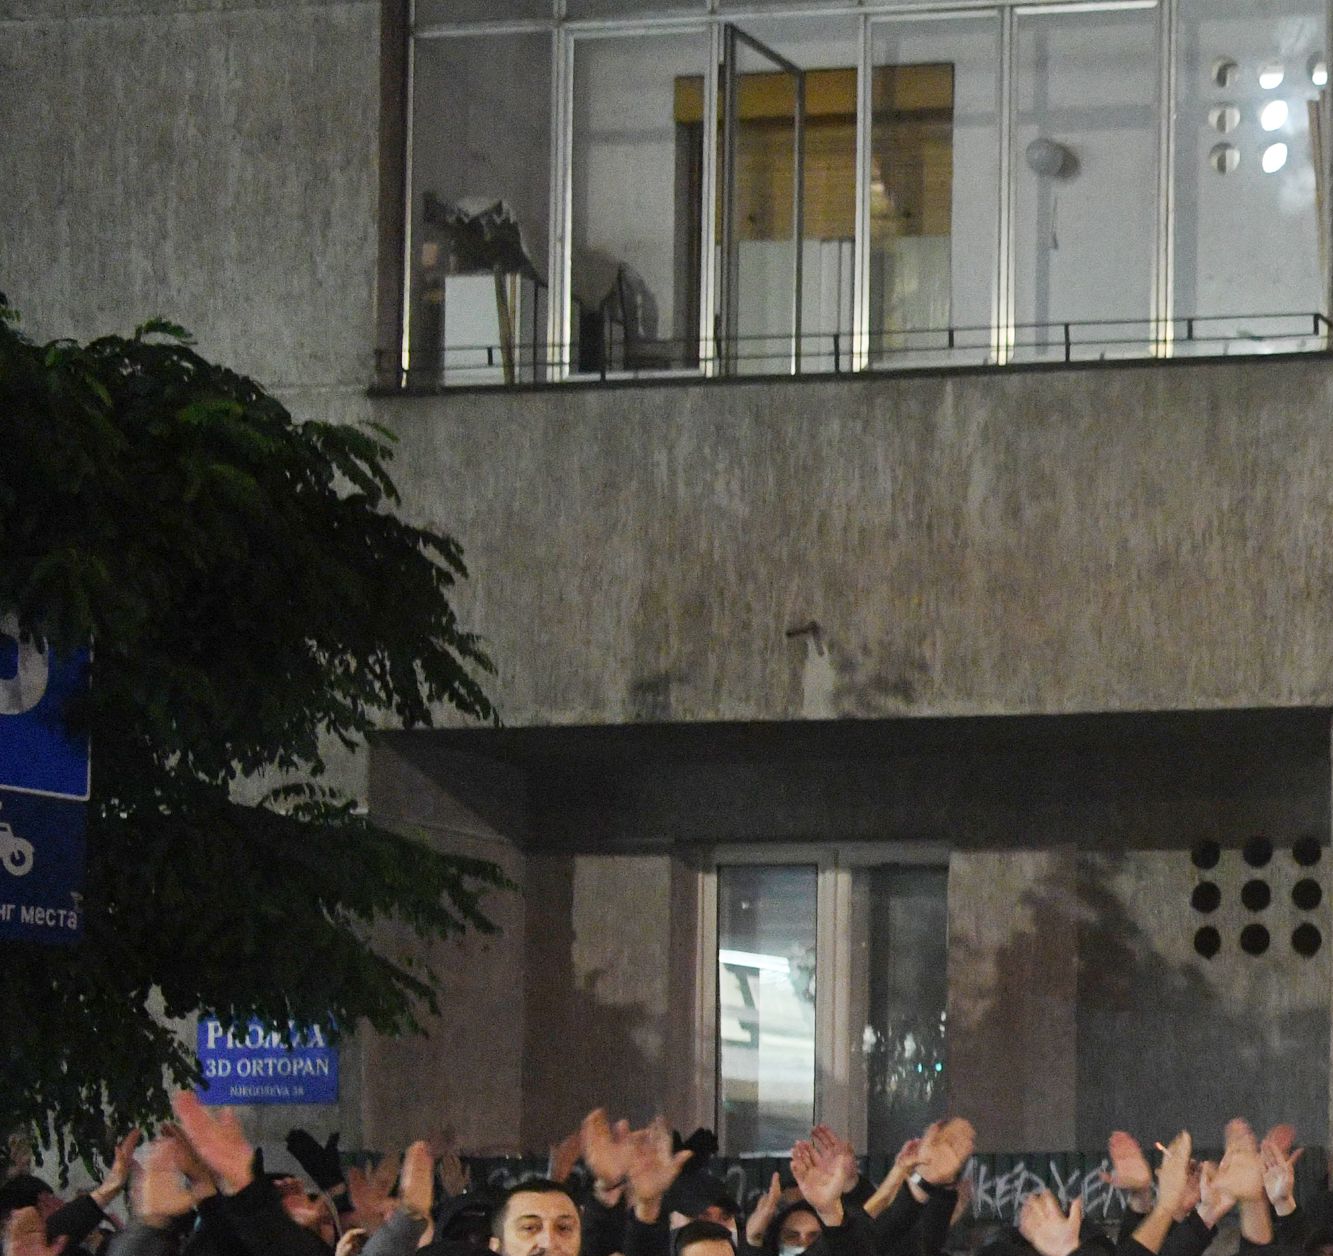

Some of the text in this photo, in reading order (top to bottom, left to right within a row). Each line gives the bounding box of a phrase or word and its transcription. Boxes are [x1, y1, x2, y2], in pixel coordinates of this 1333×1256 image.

[21, 906, 78, 930] места
[205, 1057, 329, 1077] 3D ORTOPAN
